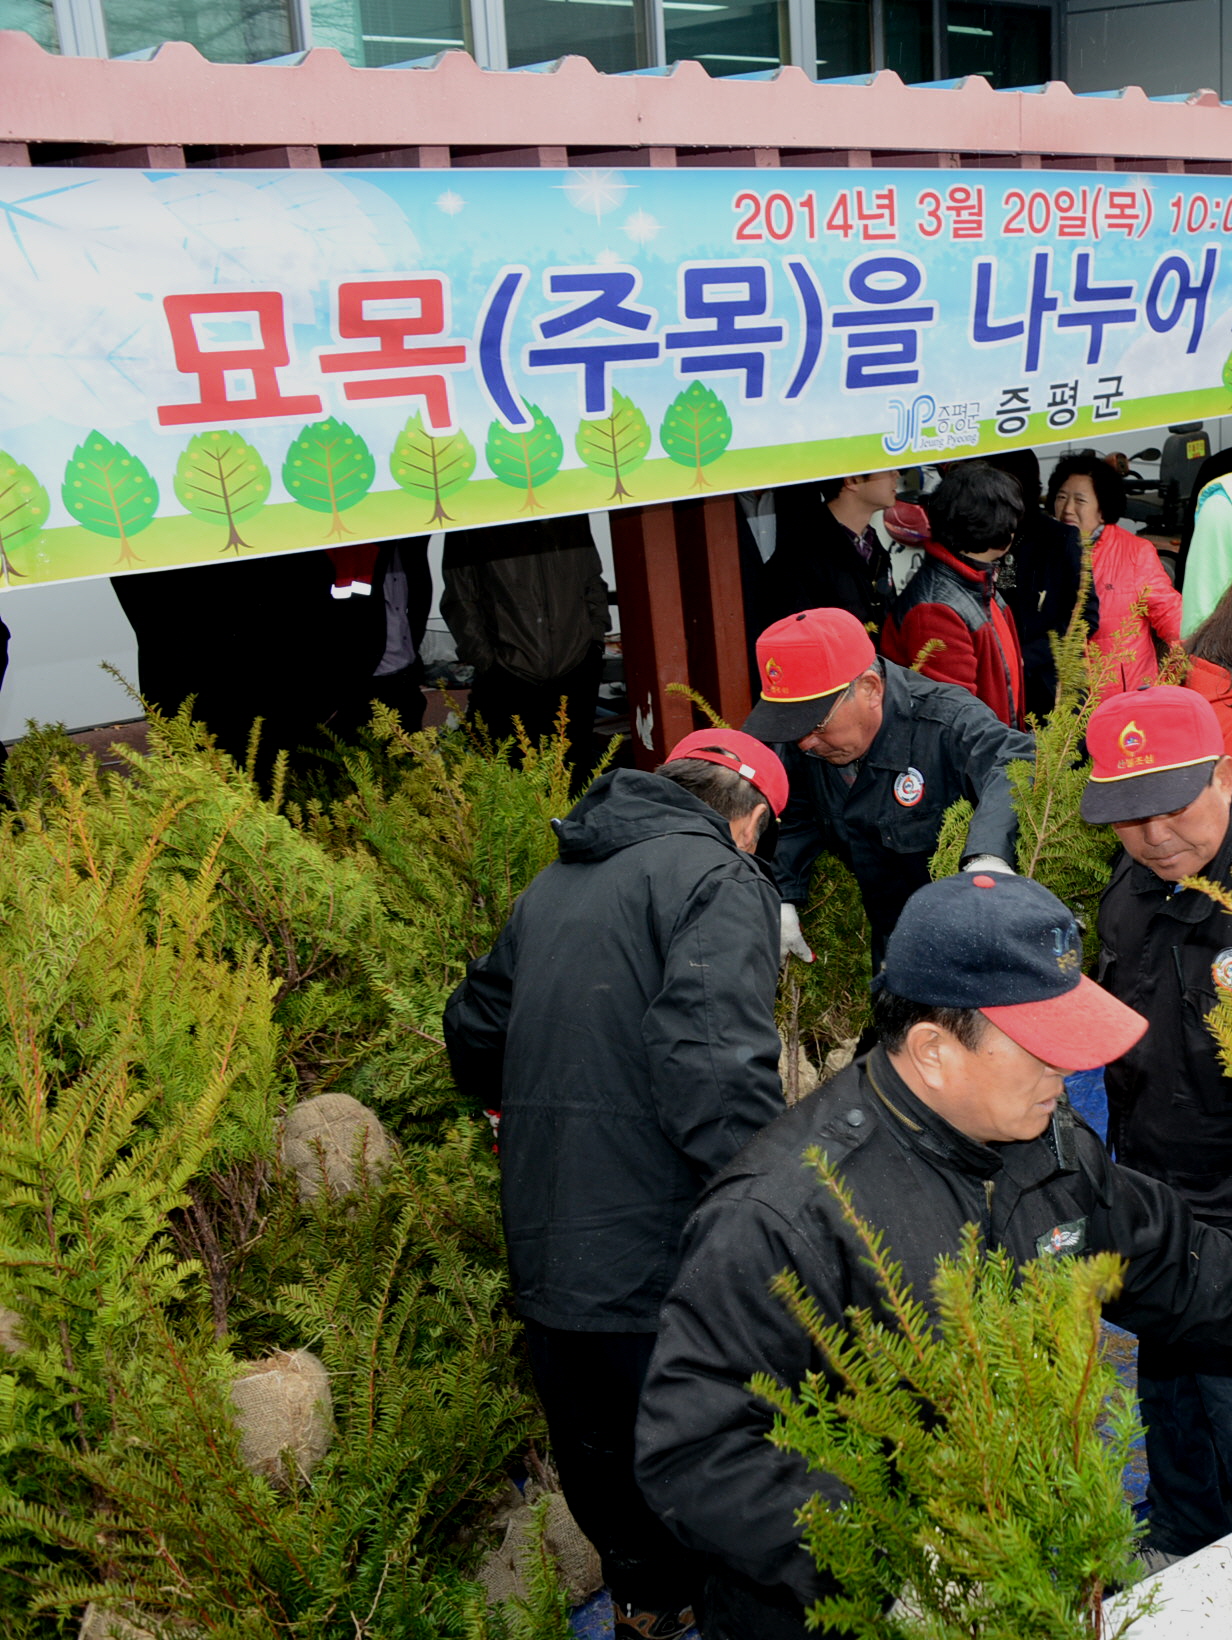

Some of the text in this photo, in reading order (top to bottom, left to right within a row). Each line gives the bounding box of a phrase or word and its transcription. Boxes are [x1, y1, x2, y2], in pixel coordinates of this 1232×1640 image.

[734, 188, 896, 241] 2014년
[918, 186, 983, 239] 3월
[1003, 187, 1153, 239] 20일(목)
[157, 256, 934, 428] 묘목(주목)을
[973, 248, 1217, 373] 나누어
[937, 402, 981, 434] 증평군
[920, 433, 977, 449] Jeung Pyeong
